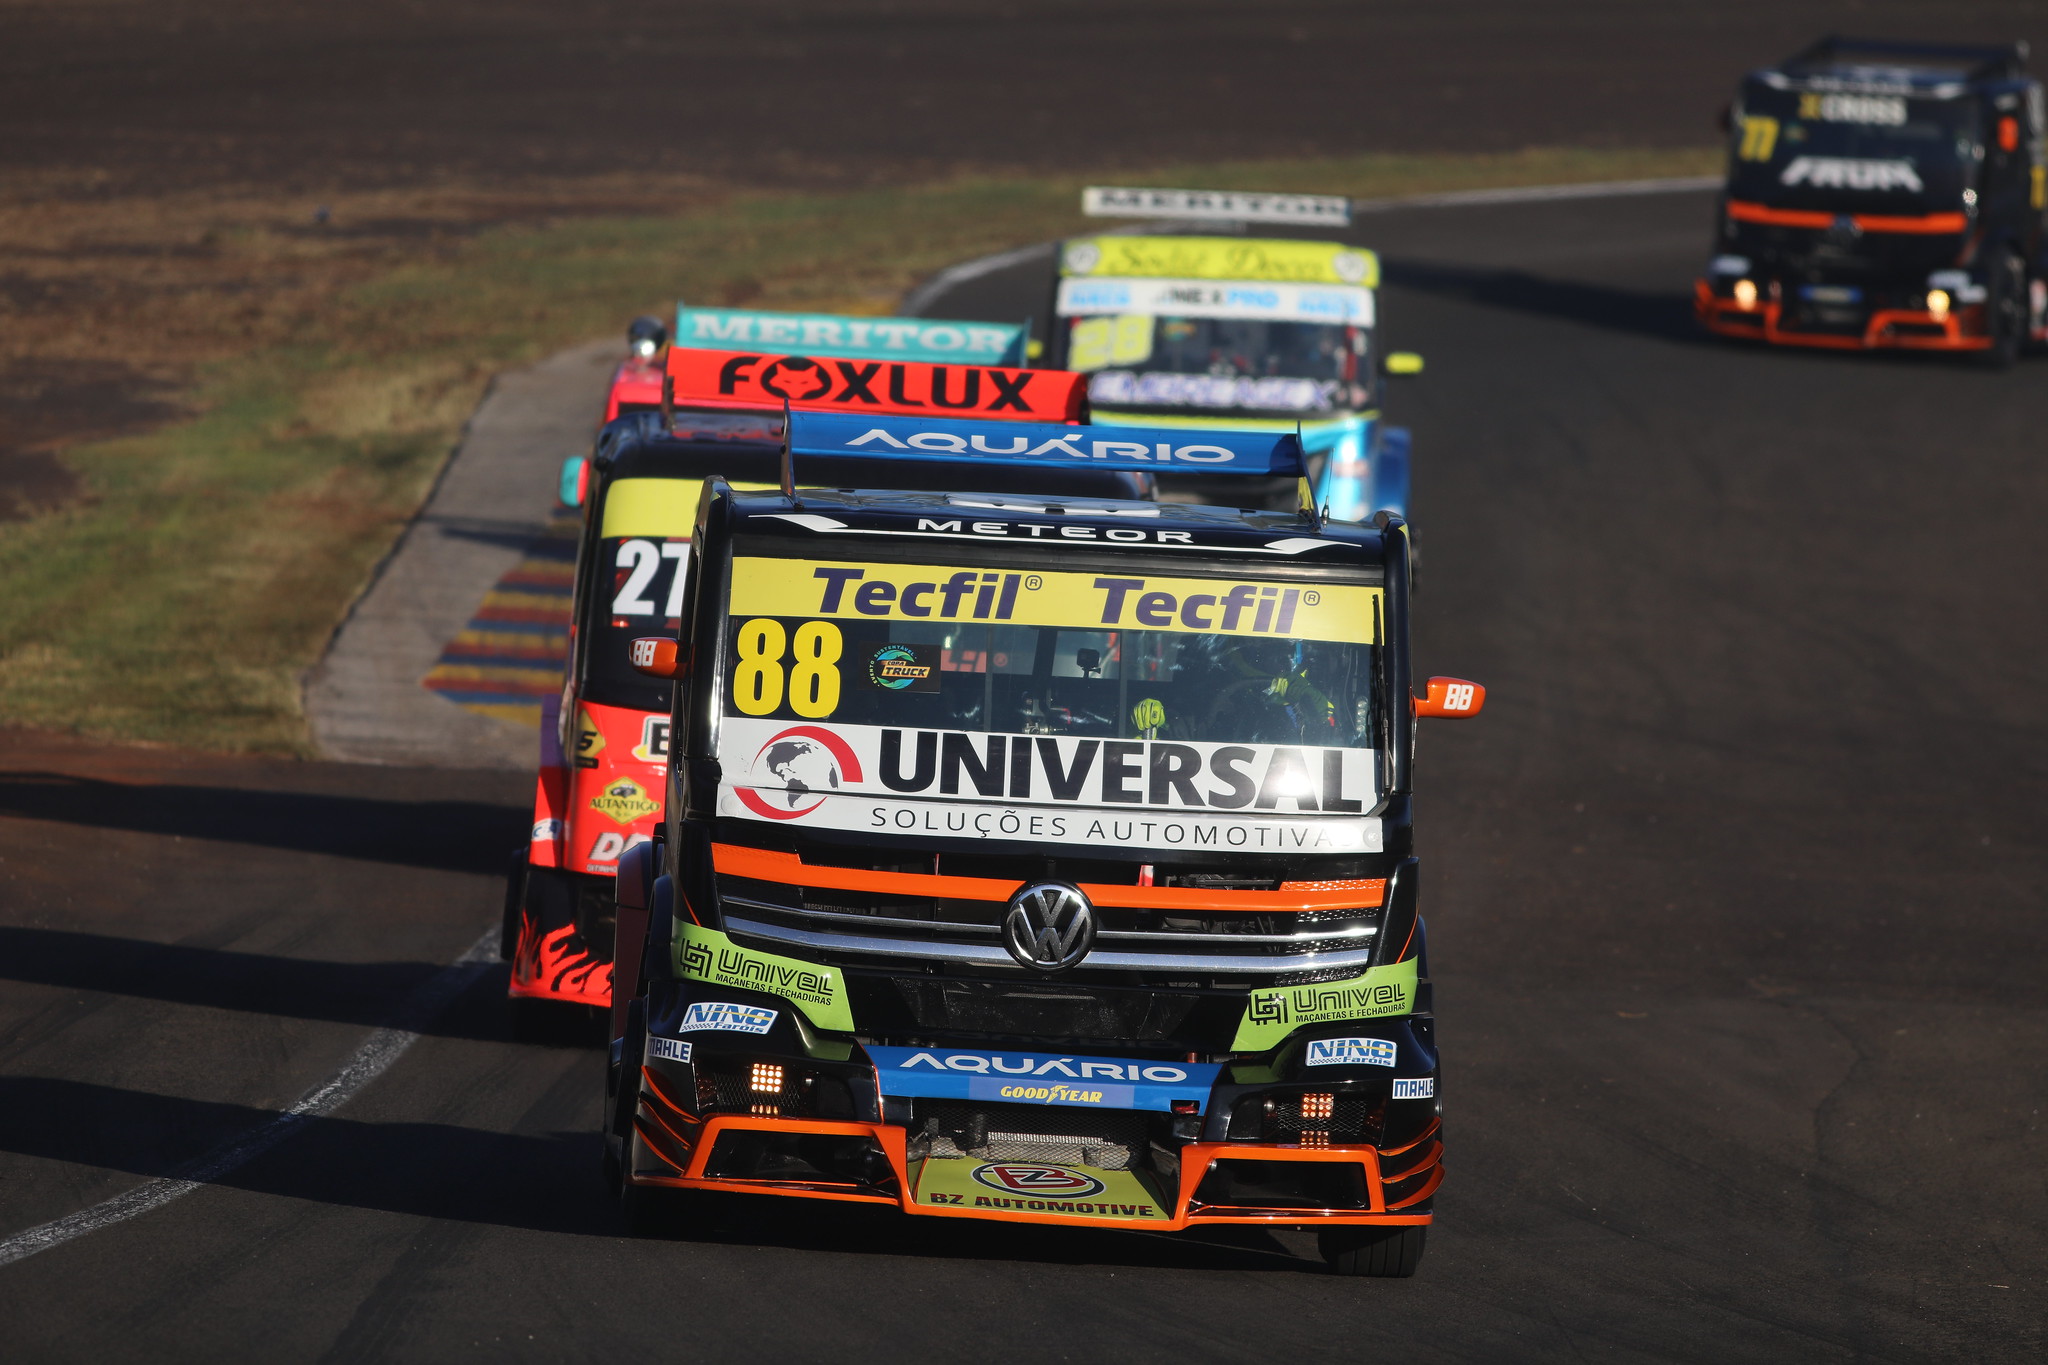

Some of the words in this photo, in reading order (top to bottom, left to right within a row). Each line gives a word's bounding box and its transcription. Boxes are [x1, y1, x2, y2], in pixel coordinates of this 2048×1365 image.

[693, 314, 1008, 353] MERITOR
[845, 429, 1235, 463] AQUÁRIO
[917, 518, 1194, 544] METEOR
[612, 539, 691, 616] 27
[633, 640, 658, 667] 88
[733, 618, 843, 718] 88
[885, 667, 928, 676] TRUCK
[1443, 684, 1474, 710] 88
[879, 729, 1362, 813] UNIVERSAL
[871, 807, 1067, 838] SOLUÇÕES
[1086, 820, 1353, 848] AUTOMOTIVA
[715, 973, 765, 992] MAÇANETAS
[768, 985, 773, 993] E
[776, 986, 831, 1006] FECHADURAS
[1295, 1010, 1347, 1023] MAÇANETAS
[1349, 1009, 1354, 1018] E
[1356, 1002, 1406, 1017] FECHADURAS
[900, 1052, 1188, 1082] AQUÁRIO
[1394, 1080, 1433, 1097] MAHLE
[930, 1193, 964, 1205] BZ
[975, 1196, 1154, 1217] AUTOMOTIVE
